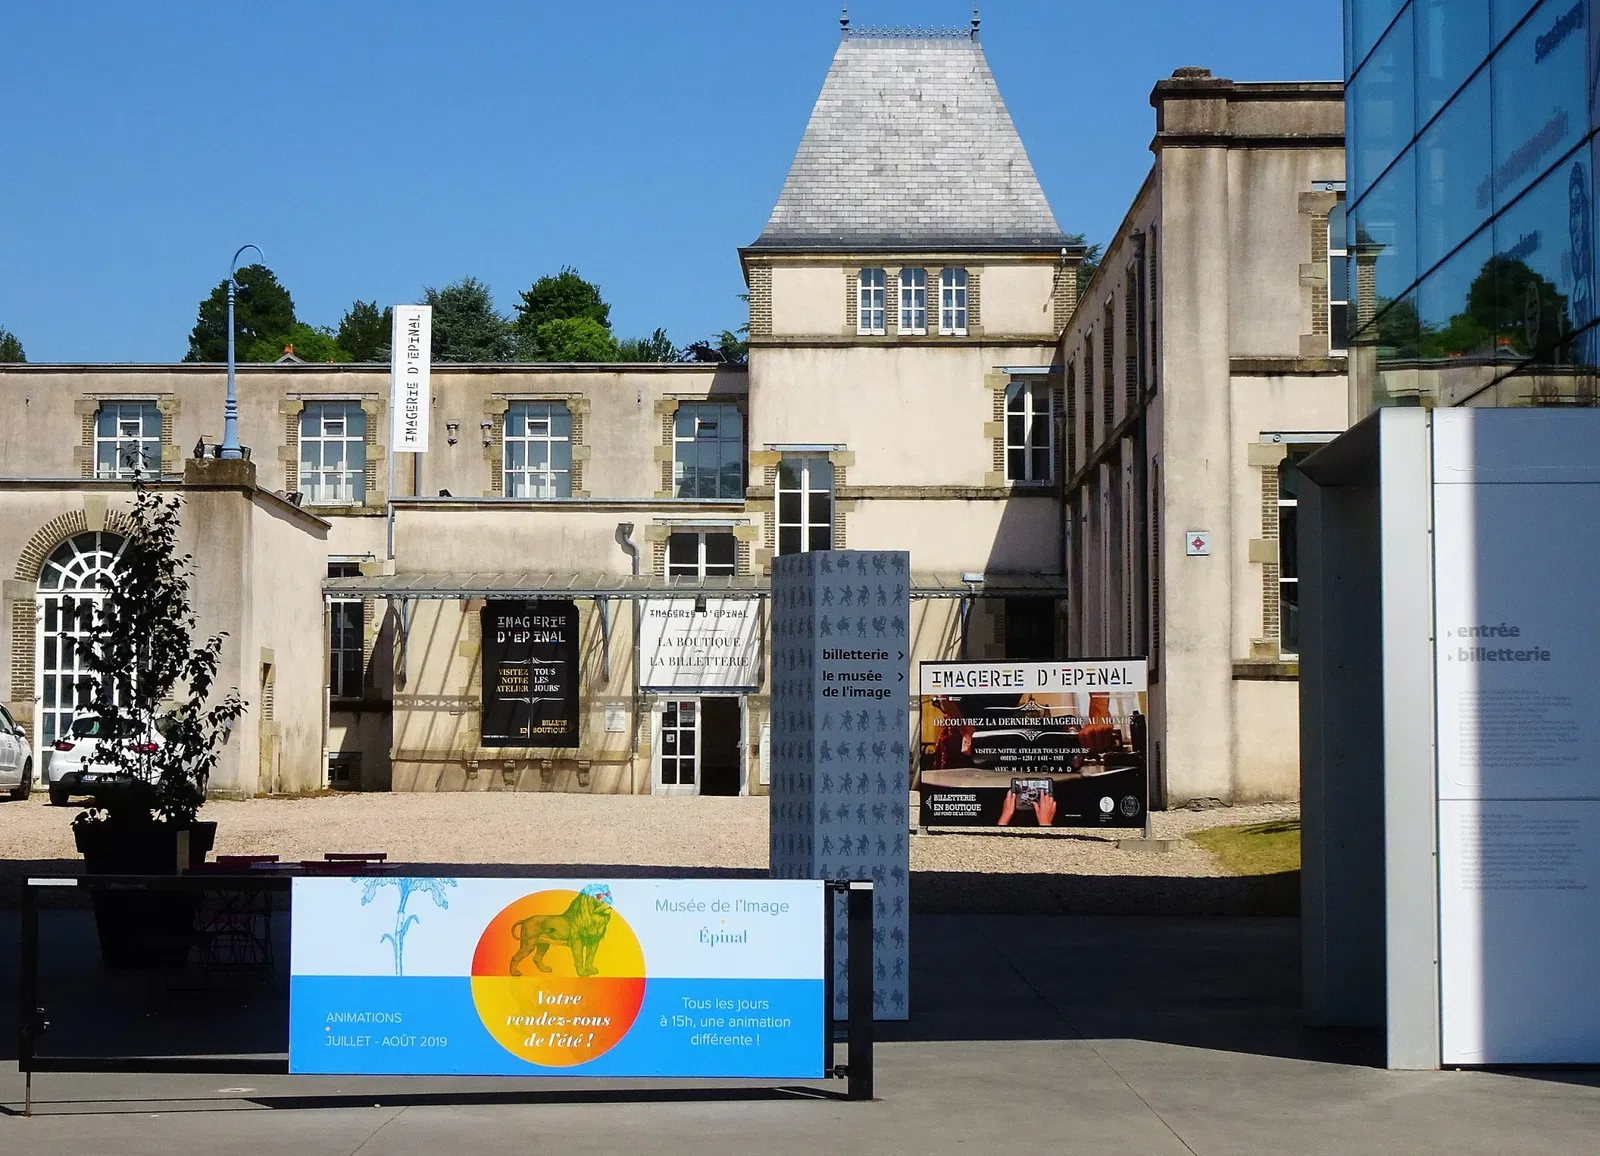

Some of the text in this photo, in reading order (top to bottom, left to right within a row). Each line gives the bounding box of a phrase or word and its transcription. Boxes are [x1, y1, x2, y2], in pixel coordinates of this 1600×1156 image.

[405, 315, 420, 442] IMAGERIE D'EPINAL
[650, 610, 748, 618] IMAGERIE D'EPINAL
[497, 616, 566, 628] IMAGERIE
[1458, 622, 1520, 638] entrée
[497, 631, 566, 643] D'EPINAL
[658, 637, 741, 648] LA BOUTIQUE
[823, 649, 888, 660] billetterie
[1458, 646, 1551, 661] billetterie
[650, 657, 749, 666] LA BILLETTERIE
[498, 668, 528, 676] VISITEZ
[534, 668, 556, 676] TOUS
[823, 670, 882, 681] le musée
[932, 667, 1133, 688] IMAGERIE D'EPINAL
[823, 686, 891, 700] de l'image
[934, 717, 984, 726] DÉCOUVREZ
[986, 718, 997, 726] LA
[998, 716, 1041, 726] DERNIÈRE
[1043, 716, 1085, 725] IMAGERIE
[1101, 716, 1134, 725] MONDE
[655, 898, 790, 915] Musée de l'Image
[699, 926, 747, 947] Épinal
[536, 990, 581, 1006] Votre
[682, 997, 769, 1012] Tous les jours
[326, 1012, 402, 1023] ANIMATIONS
[506, 1012, 611, 1027] rendez-vous
[660, 1014, 791, 1028] à 15h, une animation
[325, 1035, 370, 1047] JUILLET
[382, 1034, 416, 1047] AOÛT
[420, 1036, 447, 1047] 2019
[524, 1033, 544, 1047] de
[547, 1033, 582, 1047] l'été
[691, 1033, 752, 1045] différente
